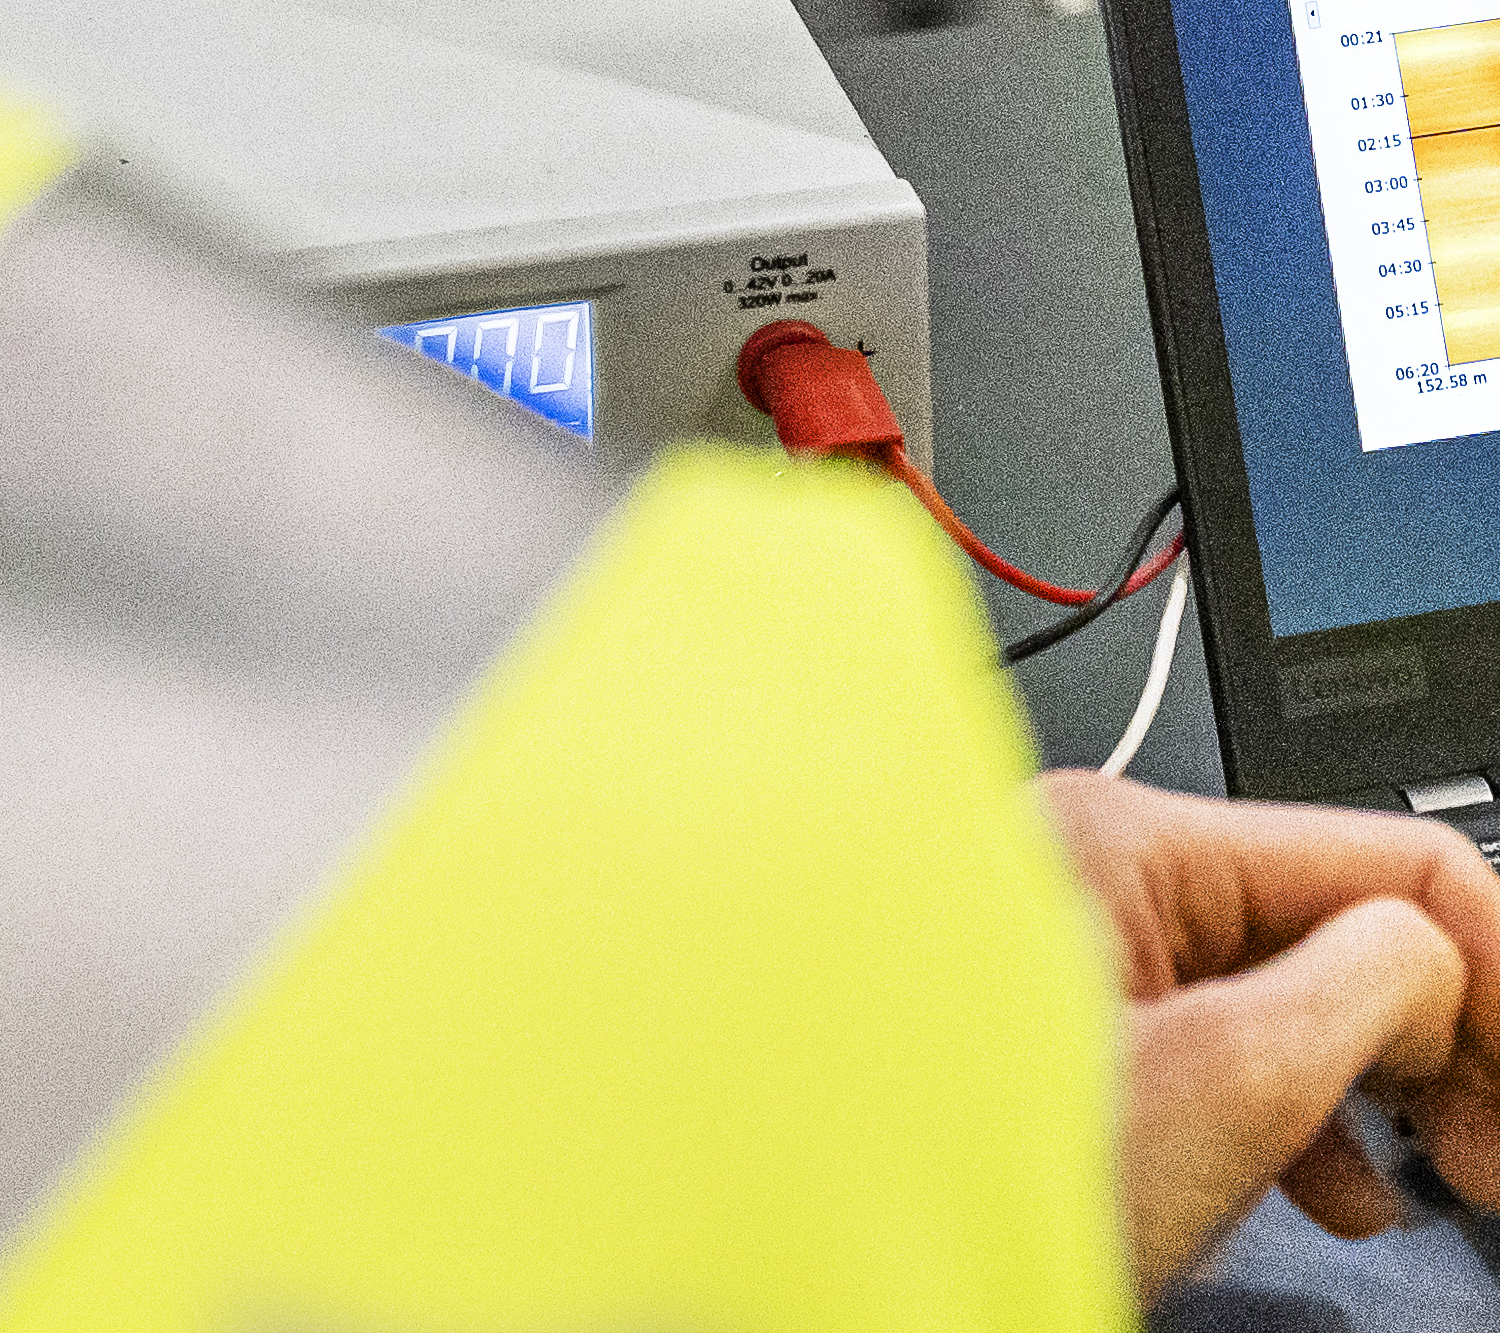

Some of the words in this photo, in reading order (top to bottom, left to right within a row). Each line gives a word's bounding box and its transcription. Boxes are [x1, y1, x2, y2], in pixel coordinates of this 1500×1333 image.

[1341, 31, 1382, 47] 00:21
[1351, 93, 1393, 110] 01:30
[1358, 135, 1401, 151] 02:15
[1365, 176, 1407, 193] 03:00
[1372, 218, 1414, 235] 03:45
[751, 254, 808, 271] Output
[1379, 260, 1421, 277] 04:30
[1386, 302, 1428, 319] 05:15
[1396, 363, 1439, 381] 06:20
[1418, 375, 1467, 394] 152.58
[1474, 374, 1486, 384] m
